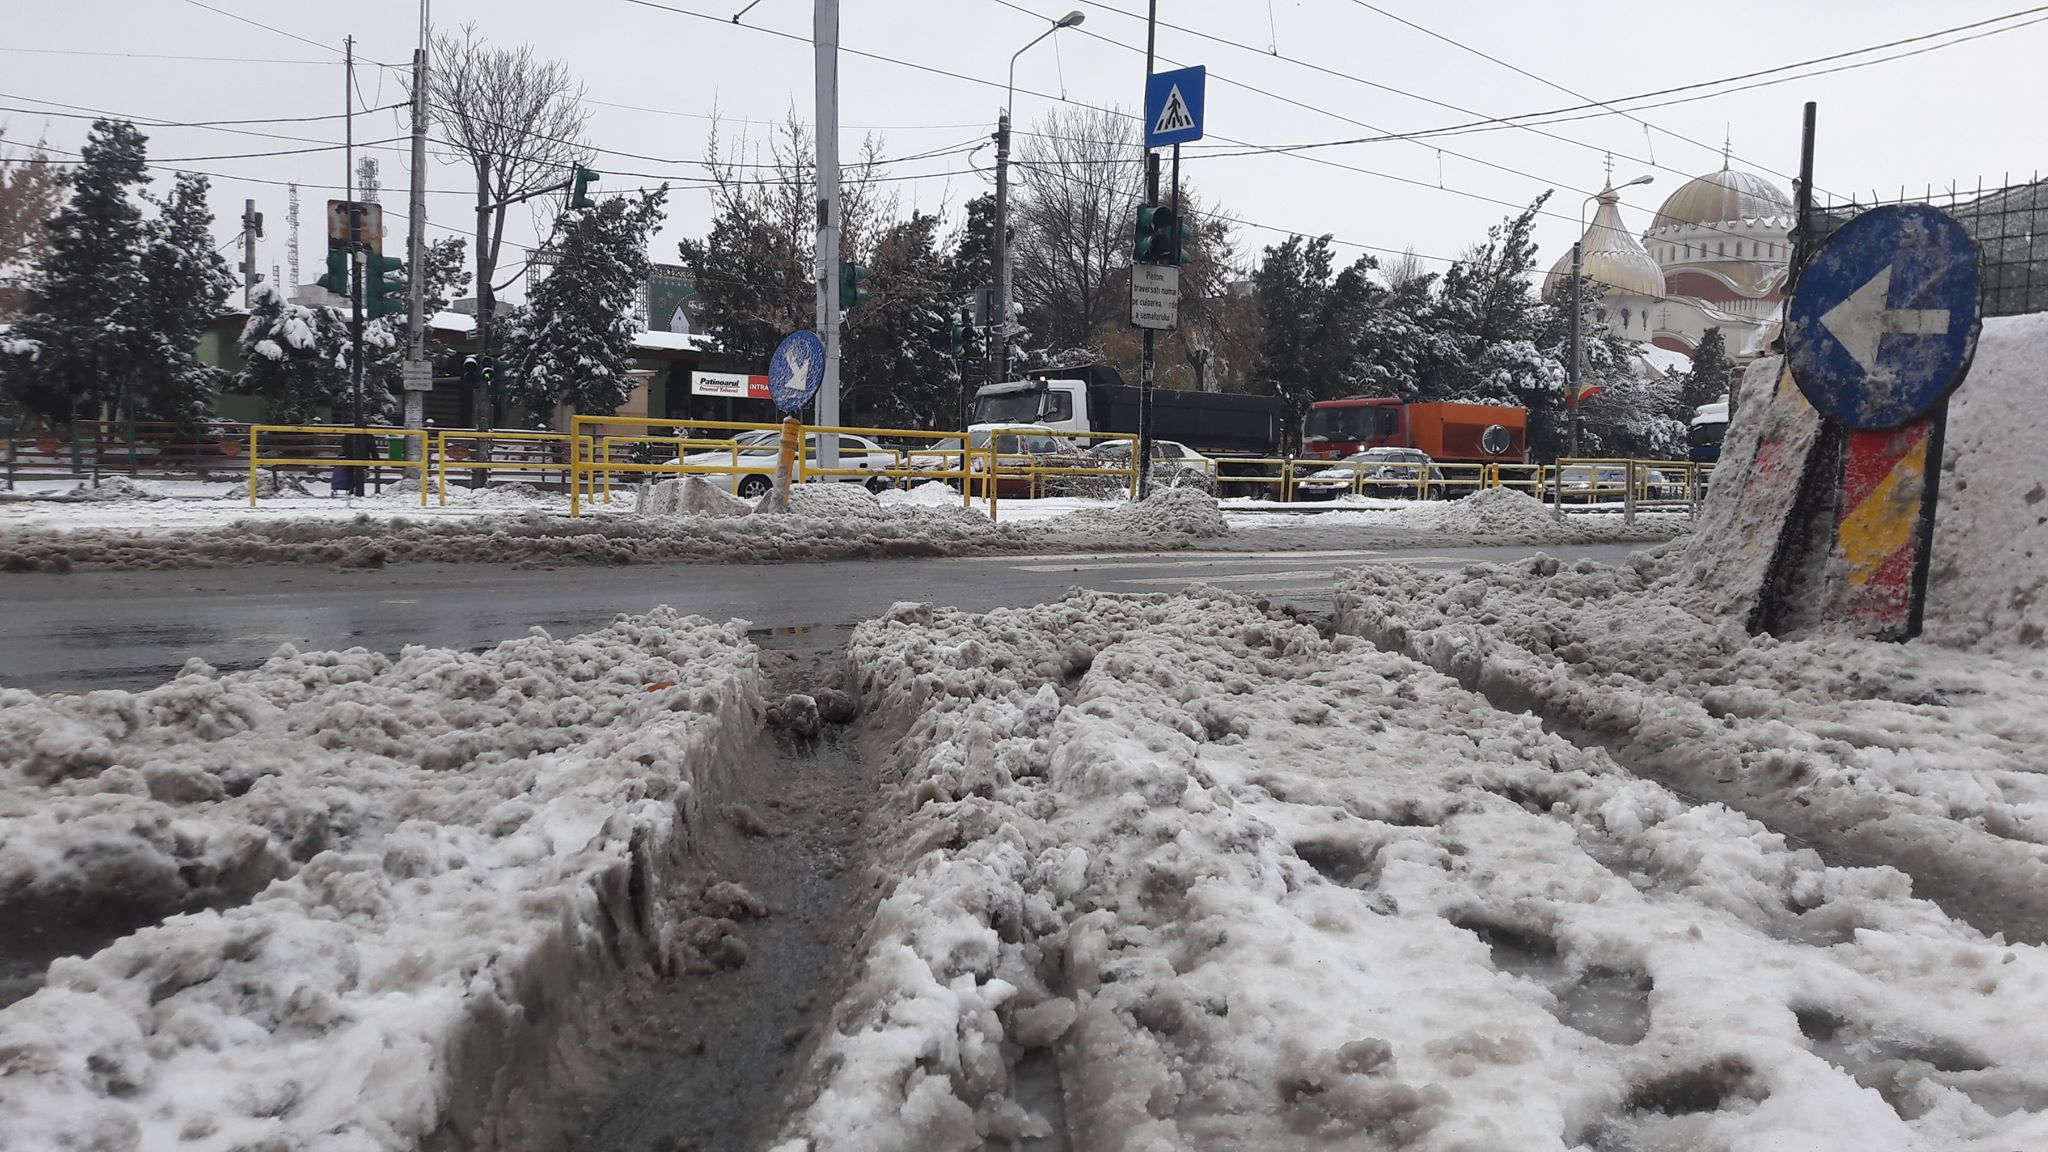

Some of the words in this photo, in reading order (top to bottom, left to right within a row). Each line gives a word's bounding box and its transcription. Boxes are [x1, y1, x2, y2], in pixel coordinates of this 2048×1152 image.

[1132, 298, 1138, 306] pe
[1140, 298, 1161, 307] culoarea
[700, 377, 740, 387] Patinoarul
[749, 383, 769, 391] INTRA
